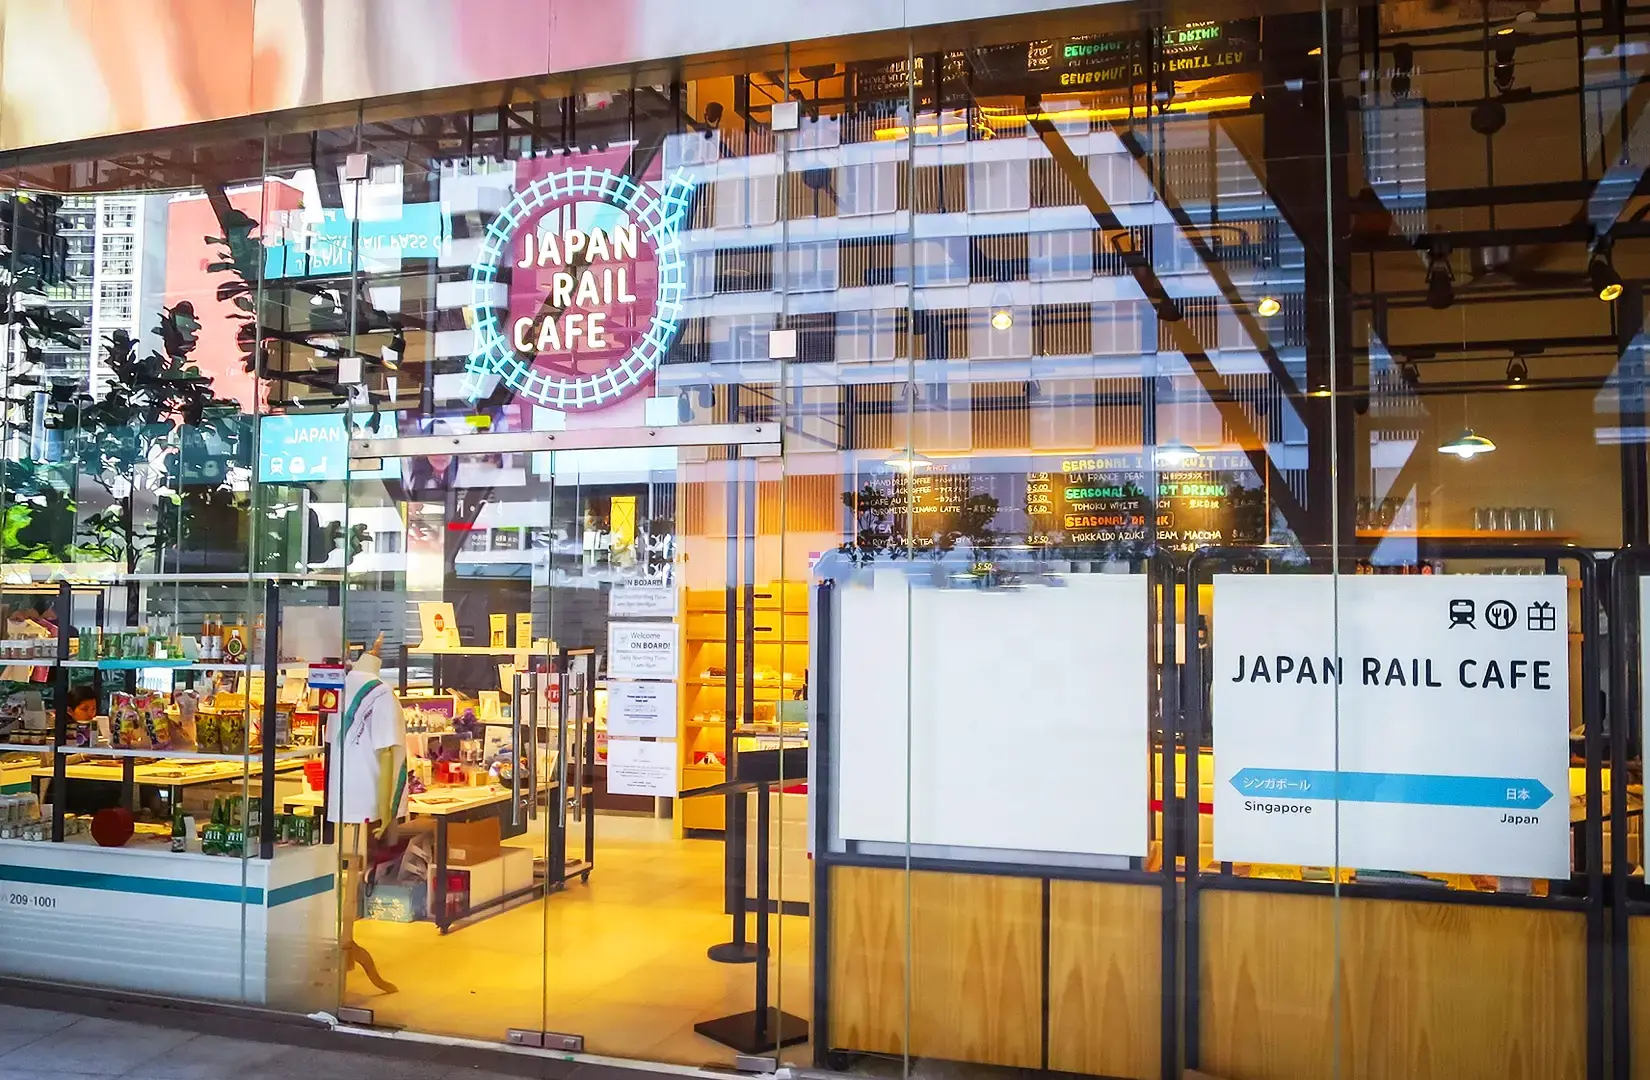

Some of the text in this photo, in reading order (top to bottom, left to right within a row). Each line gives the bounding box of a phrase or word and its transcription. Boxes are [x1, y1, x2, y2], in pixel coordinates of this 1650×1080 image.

[518, 223, 637, 268] JAPAN
[553, 268, 636, 308] RAIL
[514, 312, 607, 353] CAFE
[288, 426, 341, 444] JAPAN
[1062, 457, 1129, 473] SEASONAL
[1070, 471, 1144, 484] LA FRANCE PEAR
[1065, 487, 1126, 499] SEASONAL
[1182, 484, 1224, 496] DRINK
[940, 505, 960, 513] LATTE
[1110, 501, 1139, 510] WHITE
[1066, 516, 1127, 527] SEASONAL
[920, 538, 933, 546] TEA
[1072, 531, 1115, 542] HOKKAIDO
[1119, 530, 1144, 541] AZUKI
[1184, 530, 1222, 541] MACCHA
[631, 632, 660, 640] Welcome
[643, 642, 671, 650] BOARD!
[1232, 655, 1551, 690] JAPAN RAIL CAFE
[1243, 776, 1311, 792] シンガポール
[1506, 788, 1530, 801] 日本
[1244, 800, 1312, 815] Singapore
[1500, 813, 1539, 826] Japan
[10, 893, 56, 908] 209-1001
